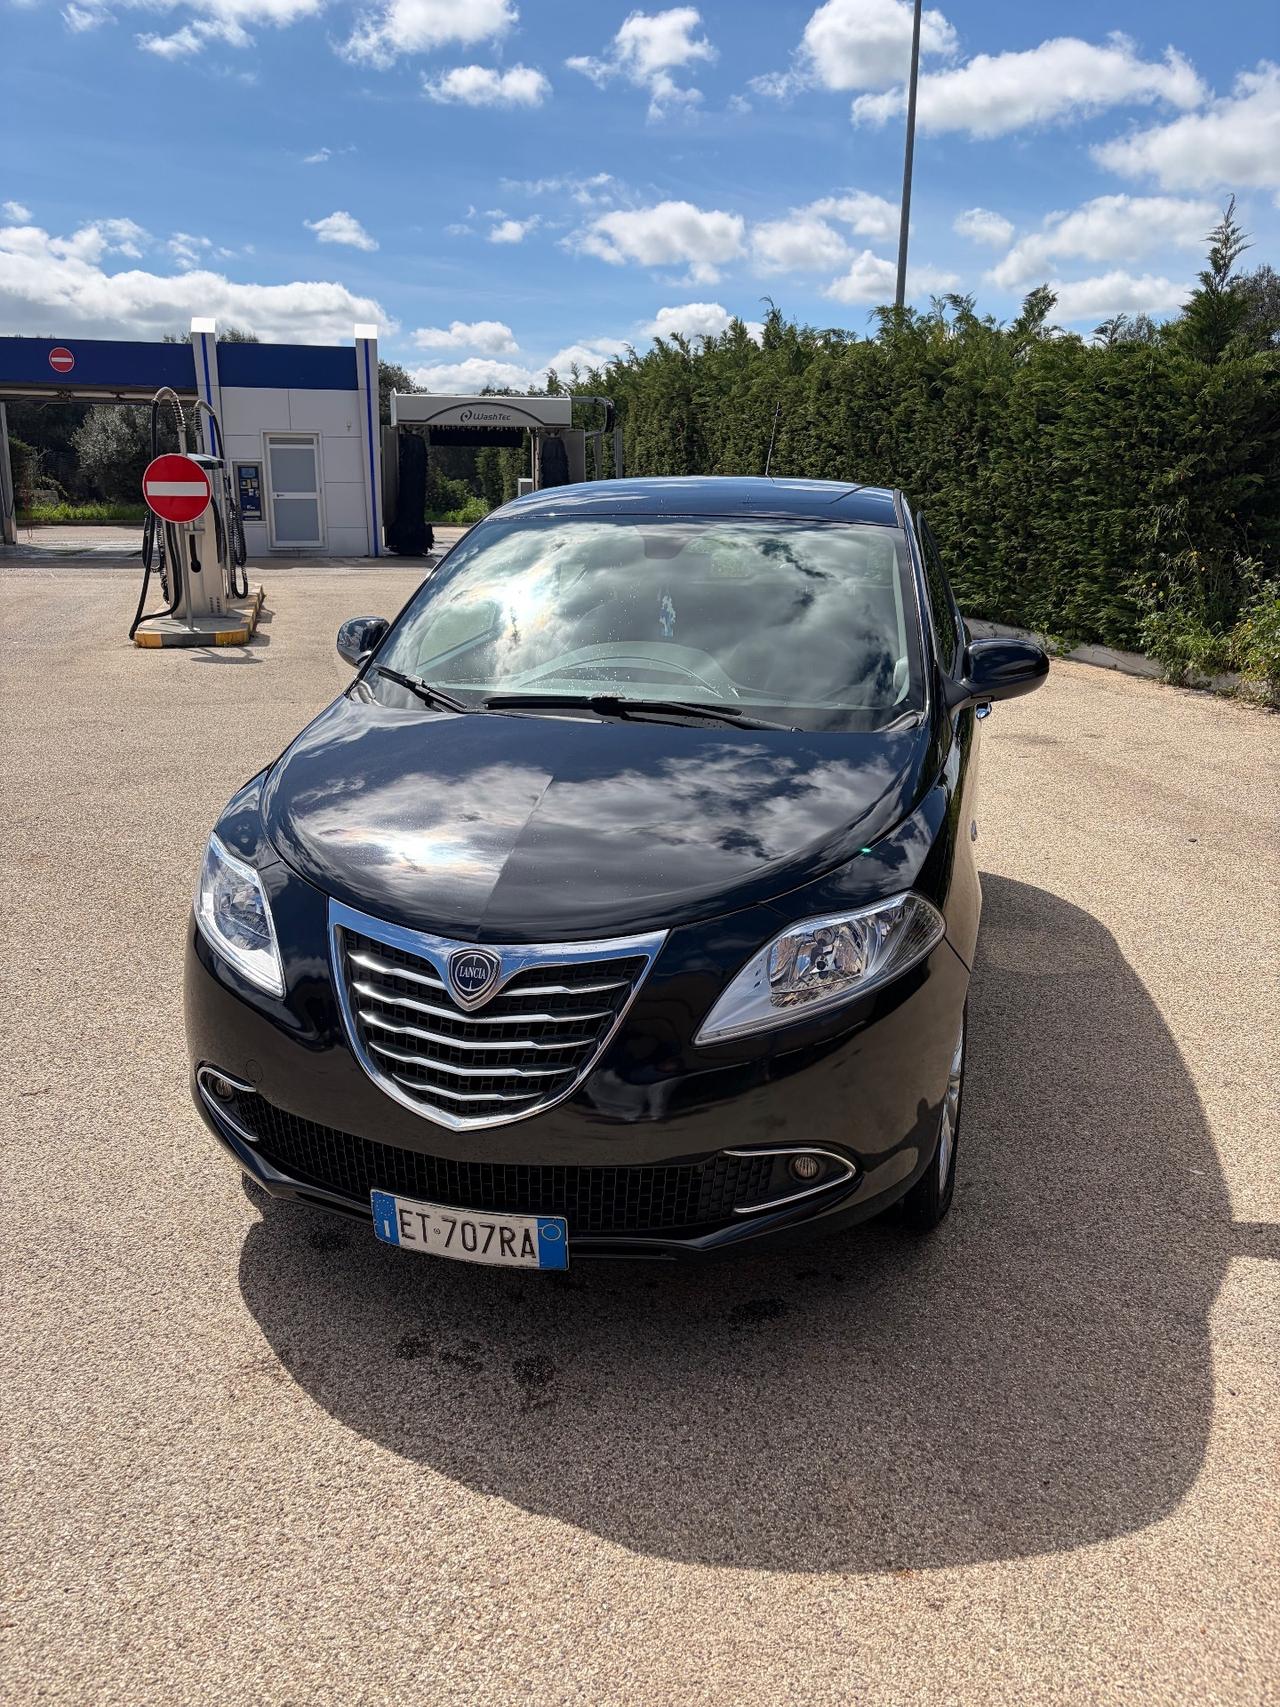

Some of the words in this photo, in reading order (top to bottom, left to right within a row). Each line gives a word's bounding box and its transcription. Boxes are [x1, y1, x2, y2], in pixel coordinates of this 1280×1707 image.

[473, 412, 512, 421] WashTec
[459, 966, 487, 980] LANCIA
[398, 1208, 431, 1244] ET
[441, 1214, 537, 1259] 707RA
